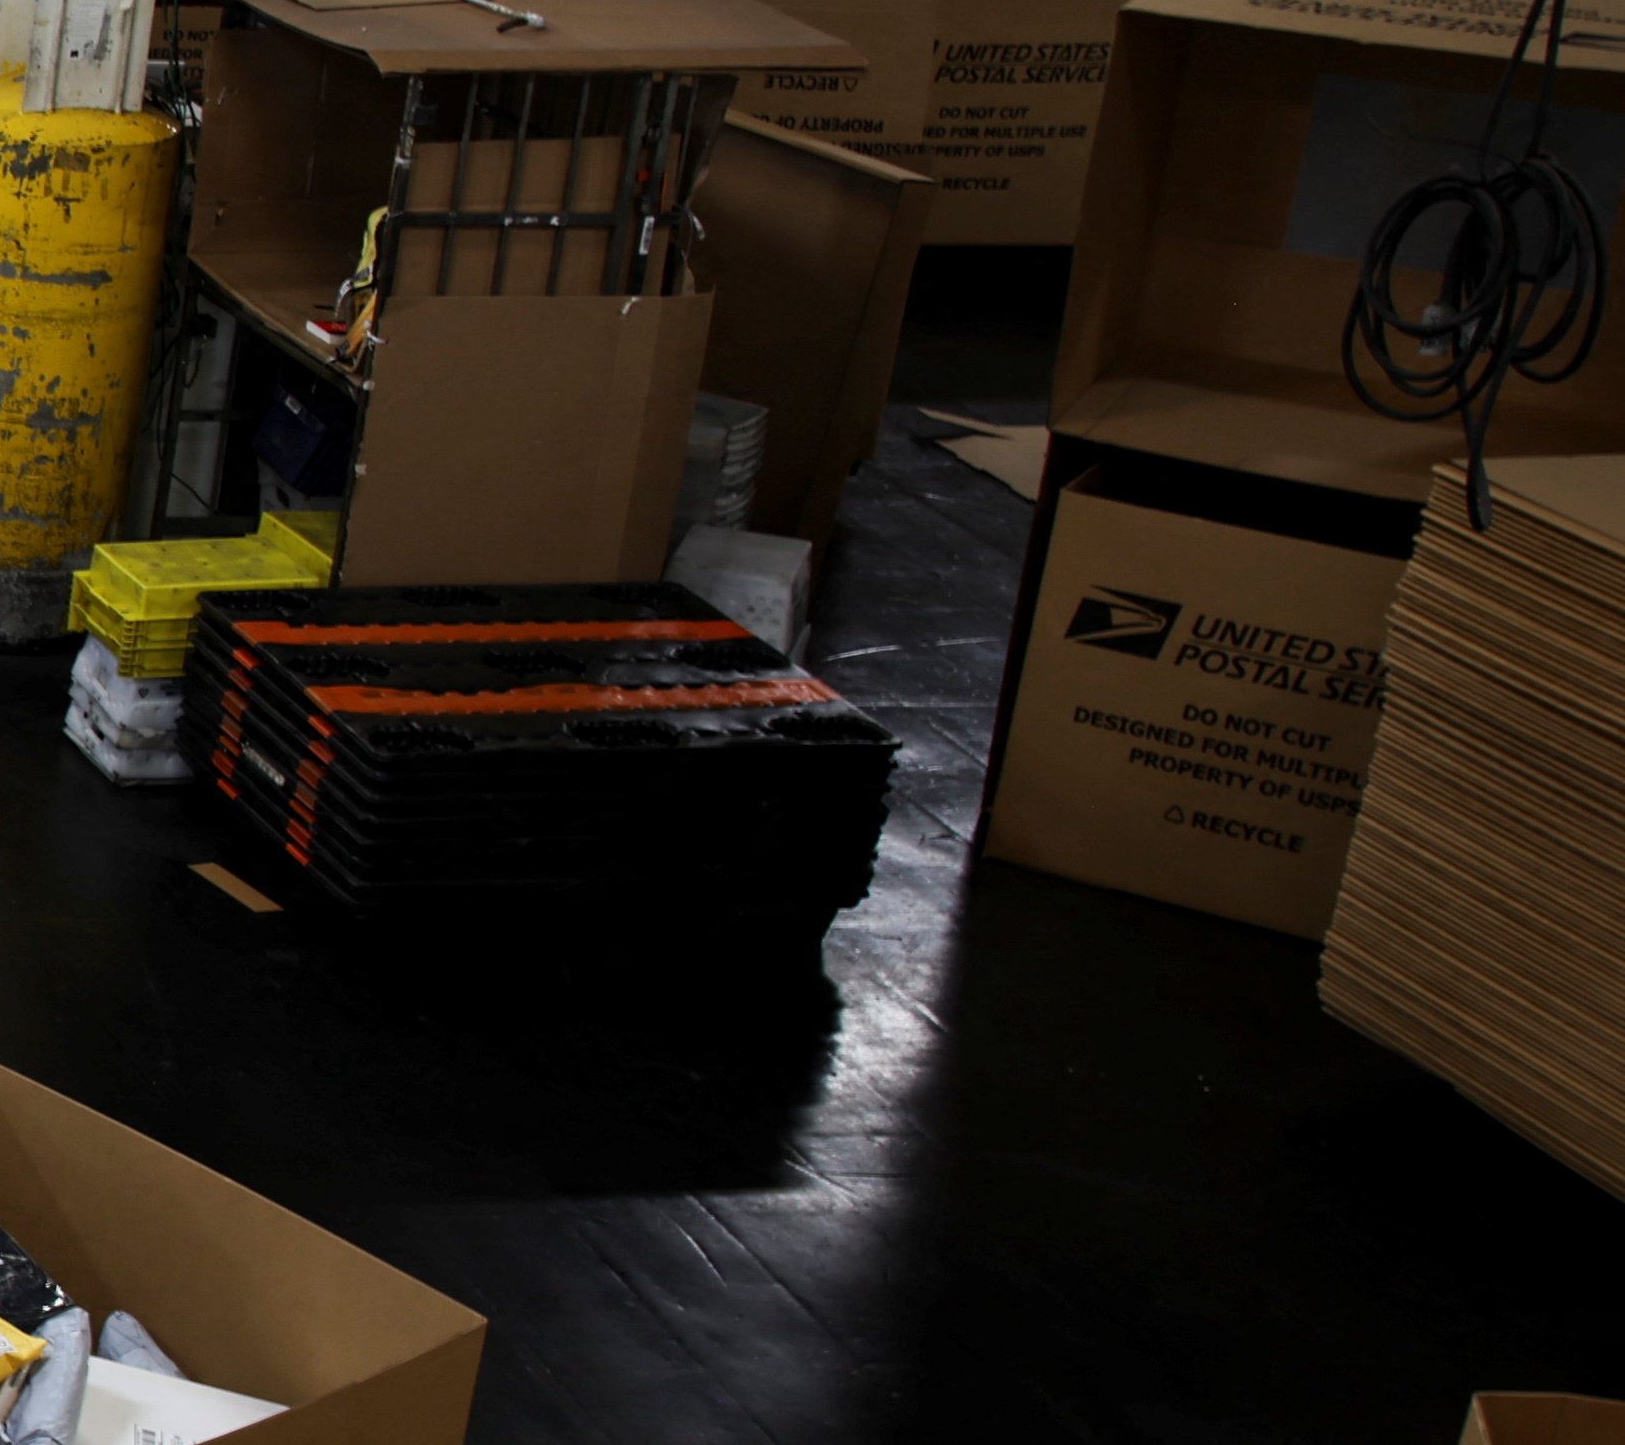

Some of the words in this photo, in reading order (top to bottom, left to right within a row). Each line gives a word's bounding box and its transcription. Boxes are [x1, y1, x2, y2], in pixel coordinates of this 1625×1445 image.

[944, 43, 1034, 64] UNITED
[1037, 42, 1111, 63] STATES
[763, 75, 839, 92] RECYCLE
[933, 64, 1017, 84] POSTAL
[939, 107, 961, 120] DO
[964, 107, 995, 120] NOT
[999, 107, 1030, 119] CUT
[957, 125, 981, 138] FOR
[983, 125, 1058, 139] MULTIPLE
[1059, 125, 1089, 138] USE
[941, 177, 1011, 191] RECYCLE
[1191, 614, 1336, 665] UNITED
[1174, 642, 1310, 695] POSTAL
[1182, 704, 1218, 726] DO
[1224, 714, 1276, 740] NOT
[1282, 726, 1333, 753] CUT
[1073, 707, 1195, 749] DESIGNED
[1200, 737, 1250, 764] FOR
[1256, 749, 1369, 791] MULTIPL
[1128, 747, 1254, 791] PROPERTY
[1258, 780, 1292, 799] OF
[1191, 810, 1305, 854] RECYCLE
